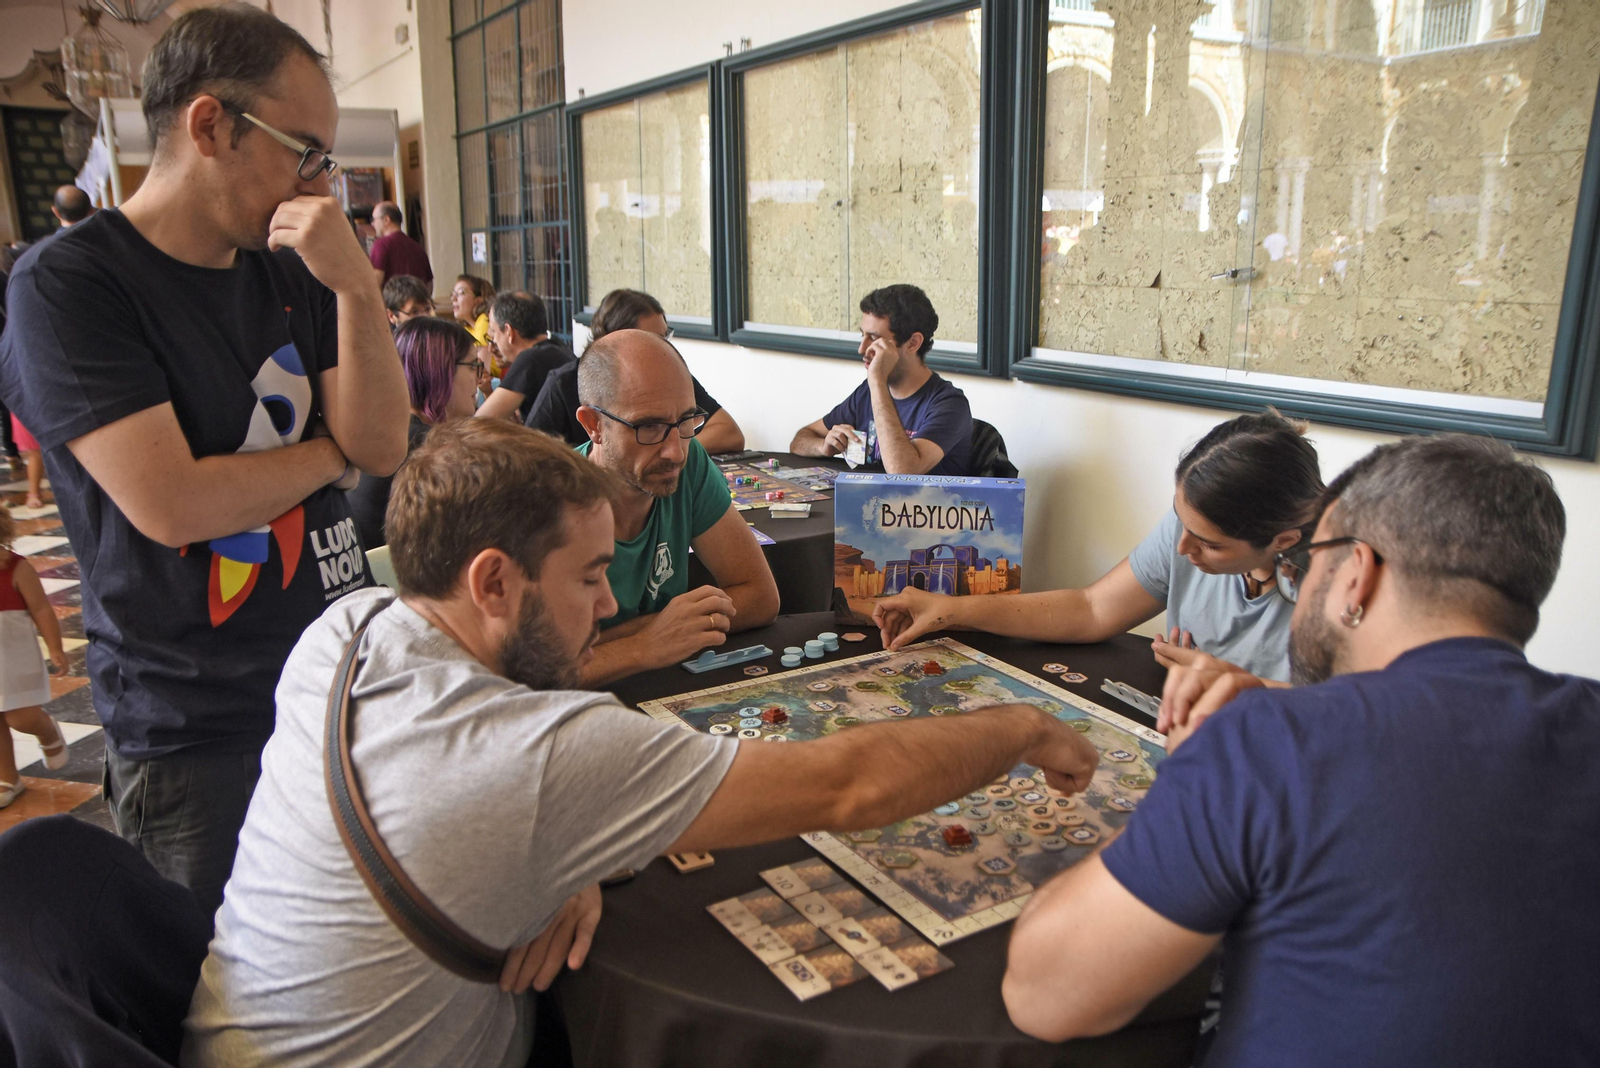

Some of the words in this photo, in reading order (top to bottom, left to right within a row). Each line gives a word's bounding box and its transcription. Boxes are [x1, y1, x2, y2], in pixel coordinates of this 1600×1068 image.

[881, 502, 995, 531] BABYLONIA
[865, 876, 882, 885] 75
[934, 929, 953, 939] 70
